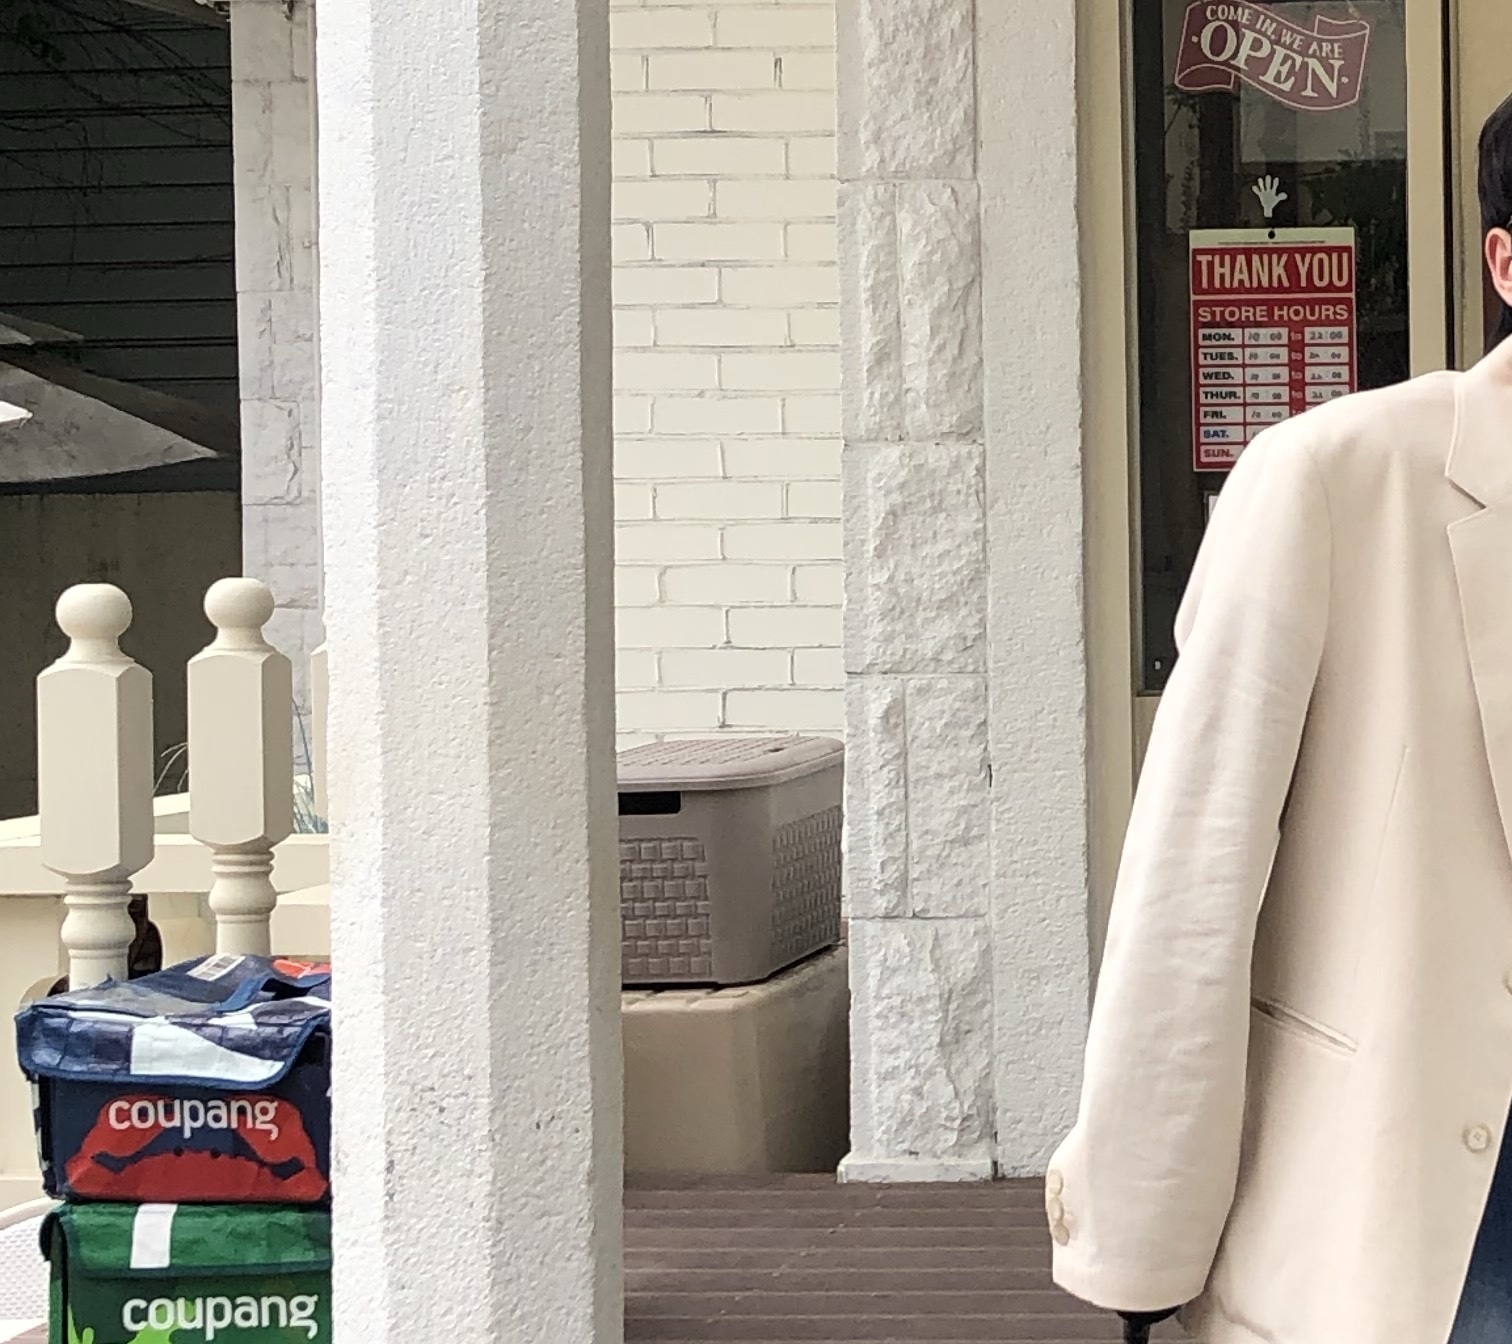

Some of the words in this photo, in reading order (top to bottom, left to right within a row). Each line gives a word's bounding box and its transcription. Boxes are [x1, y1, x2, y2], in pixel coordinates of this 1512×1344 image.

[1206, 5, 1252, 24] COME
[1281, 28, 1305, 50] WE
[1308, 41, 1343, 58] ARE
[1200, 20, 1345, 99] OPEN
[1196, 253, 1290, 289] THANK
[1294, 252, 1349, 288] YOU
[1198, 306, 1269, 322] STORE
[1274, 305, 1349, 321] HOURS
[1202, 332, 1235, 341] MON.
[1290, 331, 1302, 340] to
[1202, 352, 1239, 361] TUES.
[1202, 372, 1235, 380] WED.
[1202, 391, 1241, 400] THUR.
[1203, 410, 1226, 419] FRI.
[1203, 430, 1229, 438] SAT.
[1203, 449, 1234, 458] SUN.
[108, 1098, 279, 1141] coupang
[122, 1294, 319, 1341] coupang
